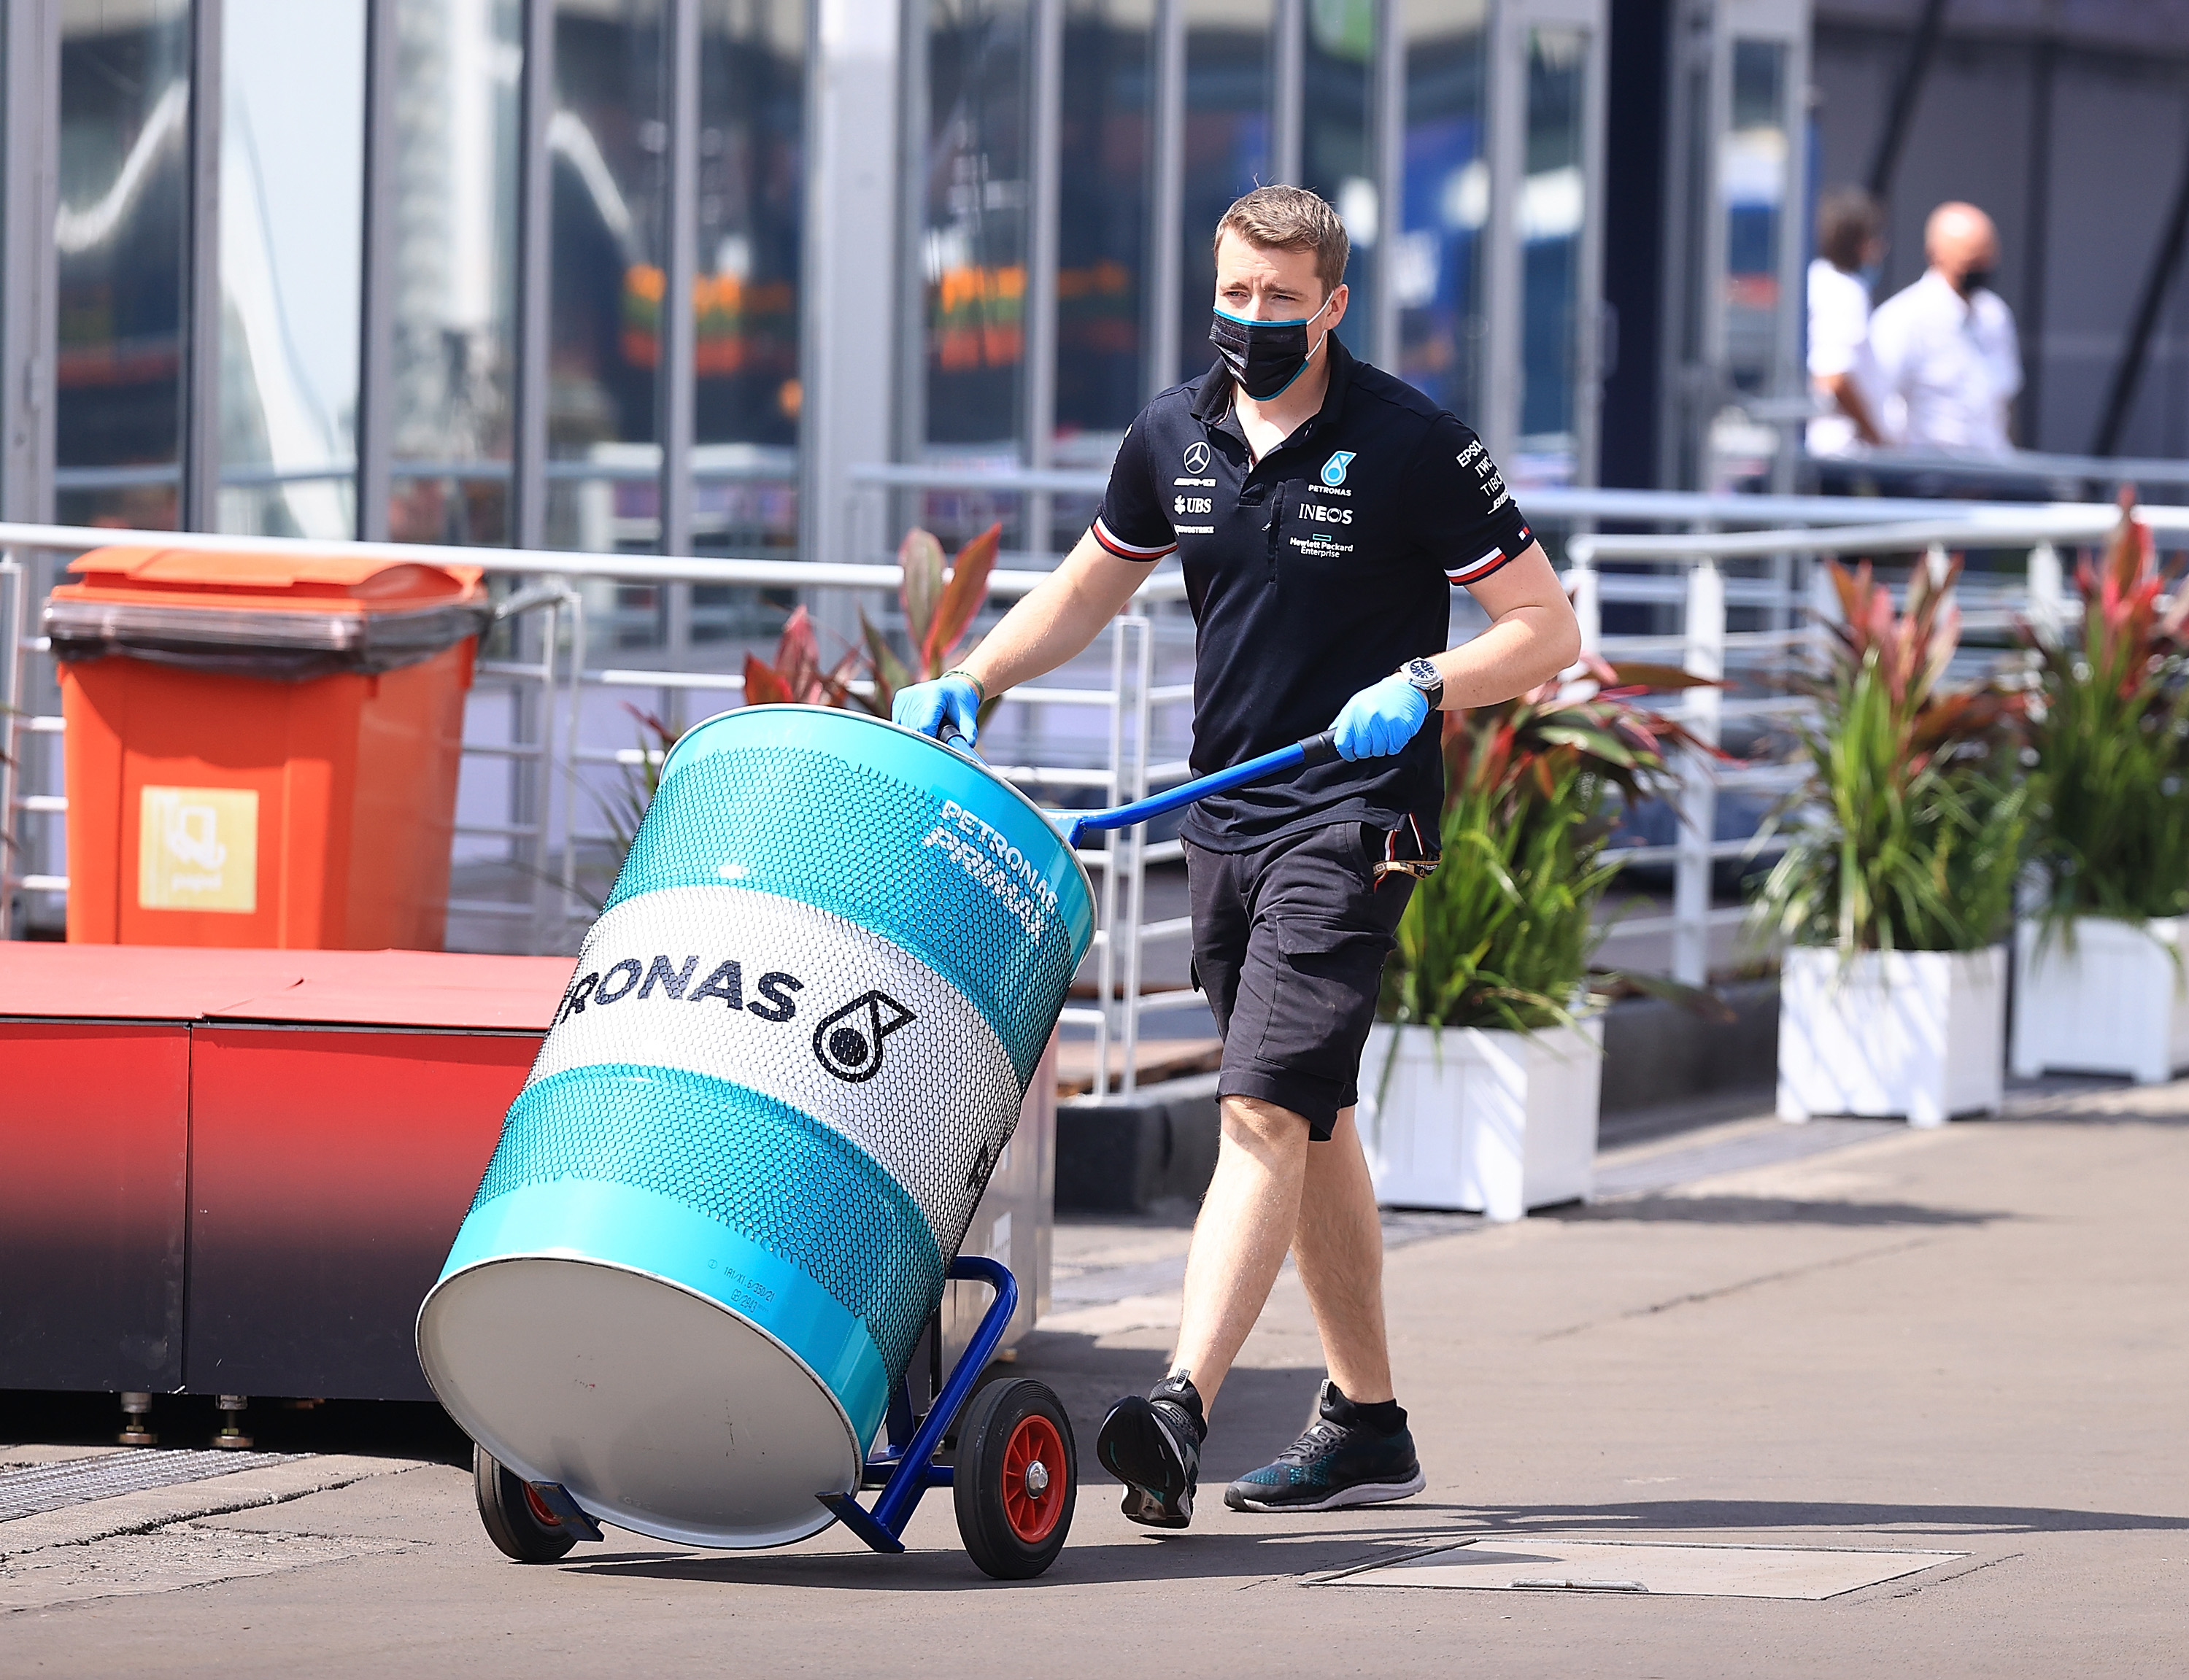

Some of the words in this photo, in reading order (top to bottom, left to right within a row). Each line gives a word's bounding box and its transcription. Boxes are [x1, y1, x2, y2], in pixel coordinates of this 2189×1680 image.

[1456, 440, 1483, 468] EPSO
[1475, 456, 1493, 479] IWC
[1308, 484, 1351, 497] PETRONAS
[1480, 470, 1503, 497] TIBC
[1186, 498, 1212, 514] UBS
[1298, 503, 1353, 524] INEOS
[1487, 489, 1509, 514] BOS
[1289, 537, 1320, 550] Hewlett
[1321, 541, 1353, 553] Packard
[1300, 546, 1340, 558] Enterprise
[941, 800, 1058, 914] PETRONAS
[557, 955, 804, 1024] RONAS
[731, 1288, 758, 1313] GB/2943
